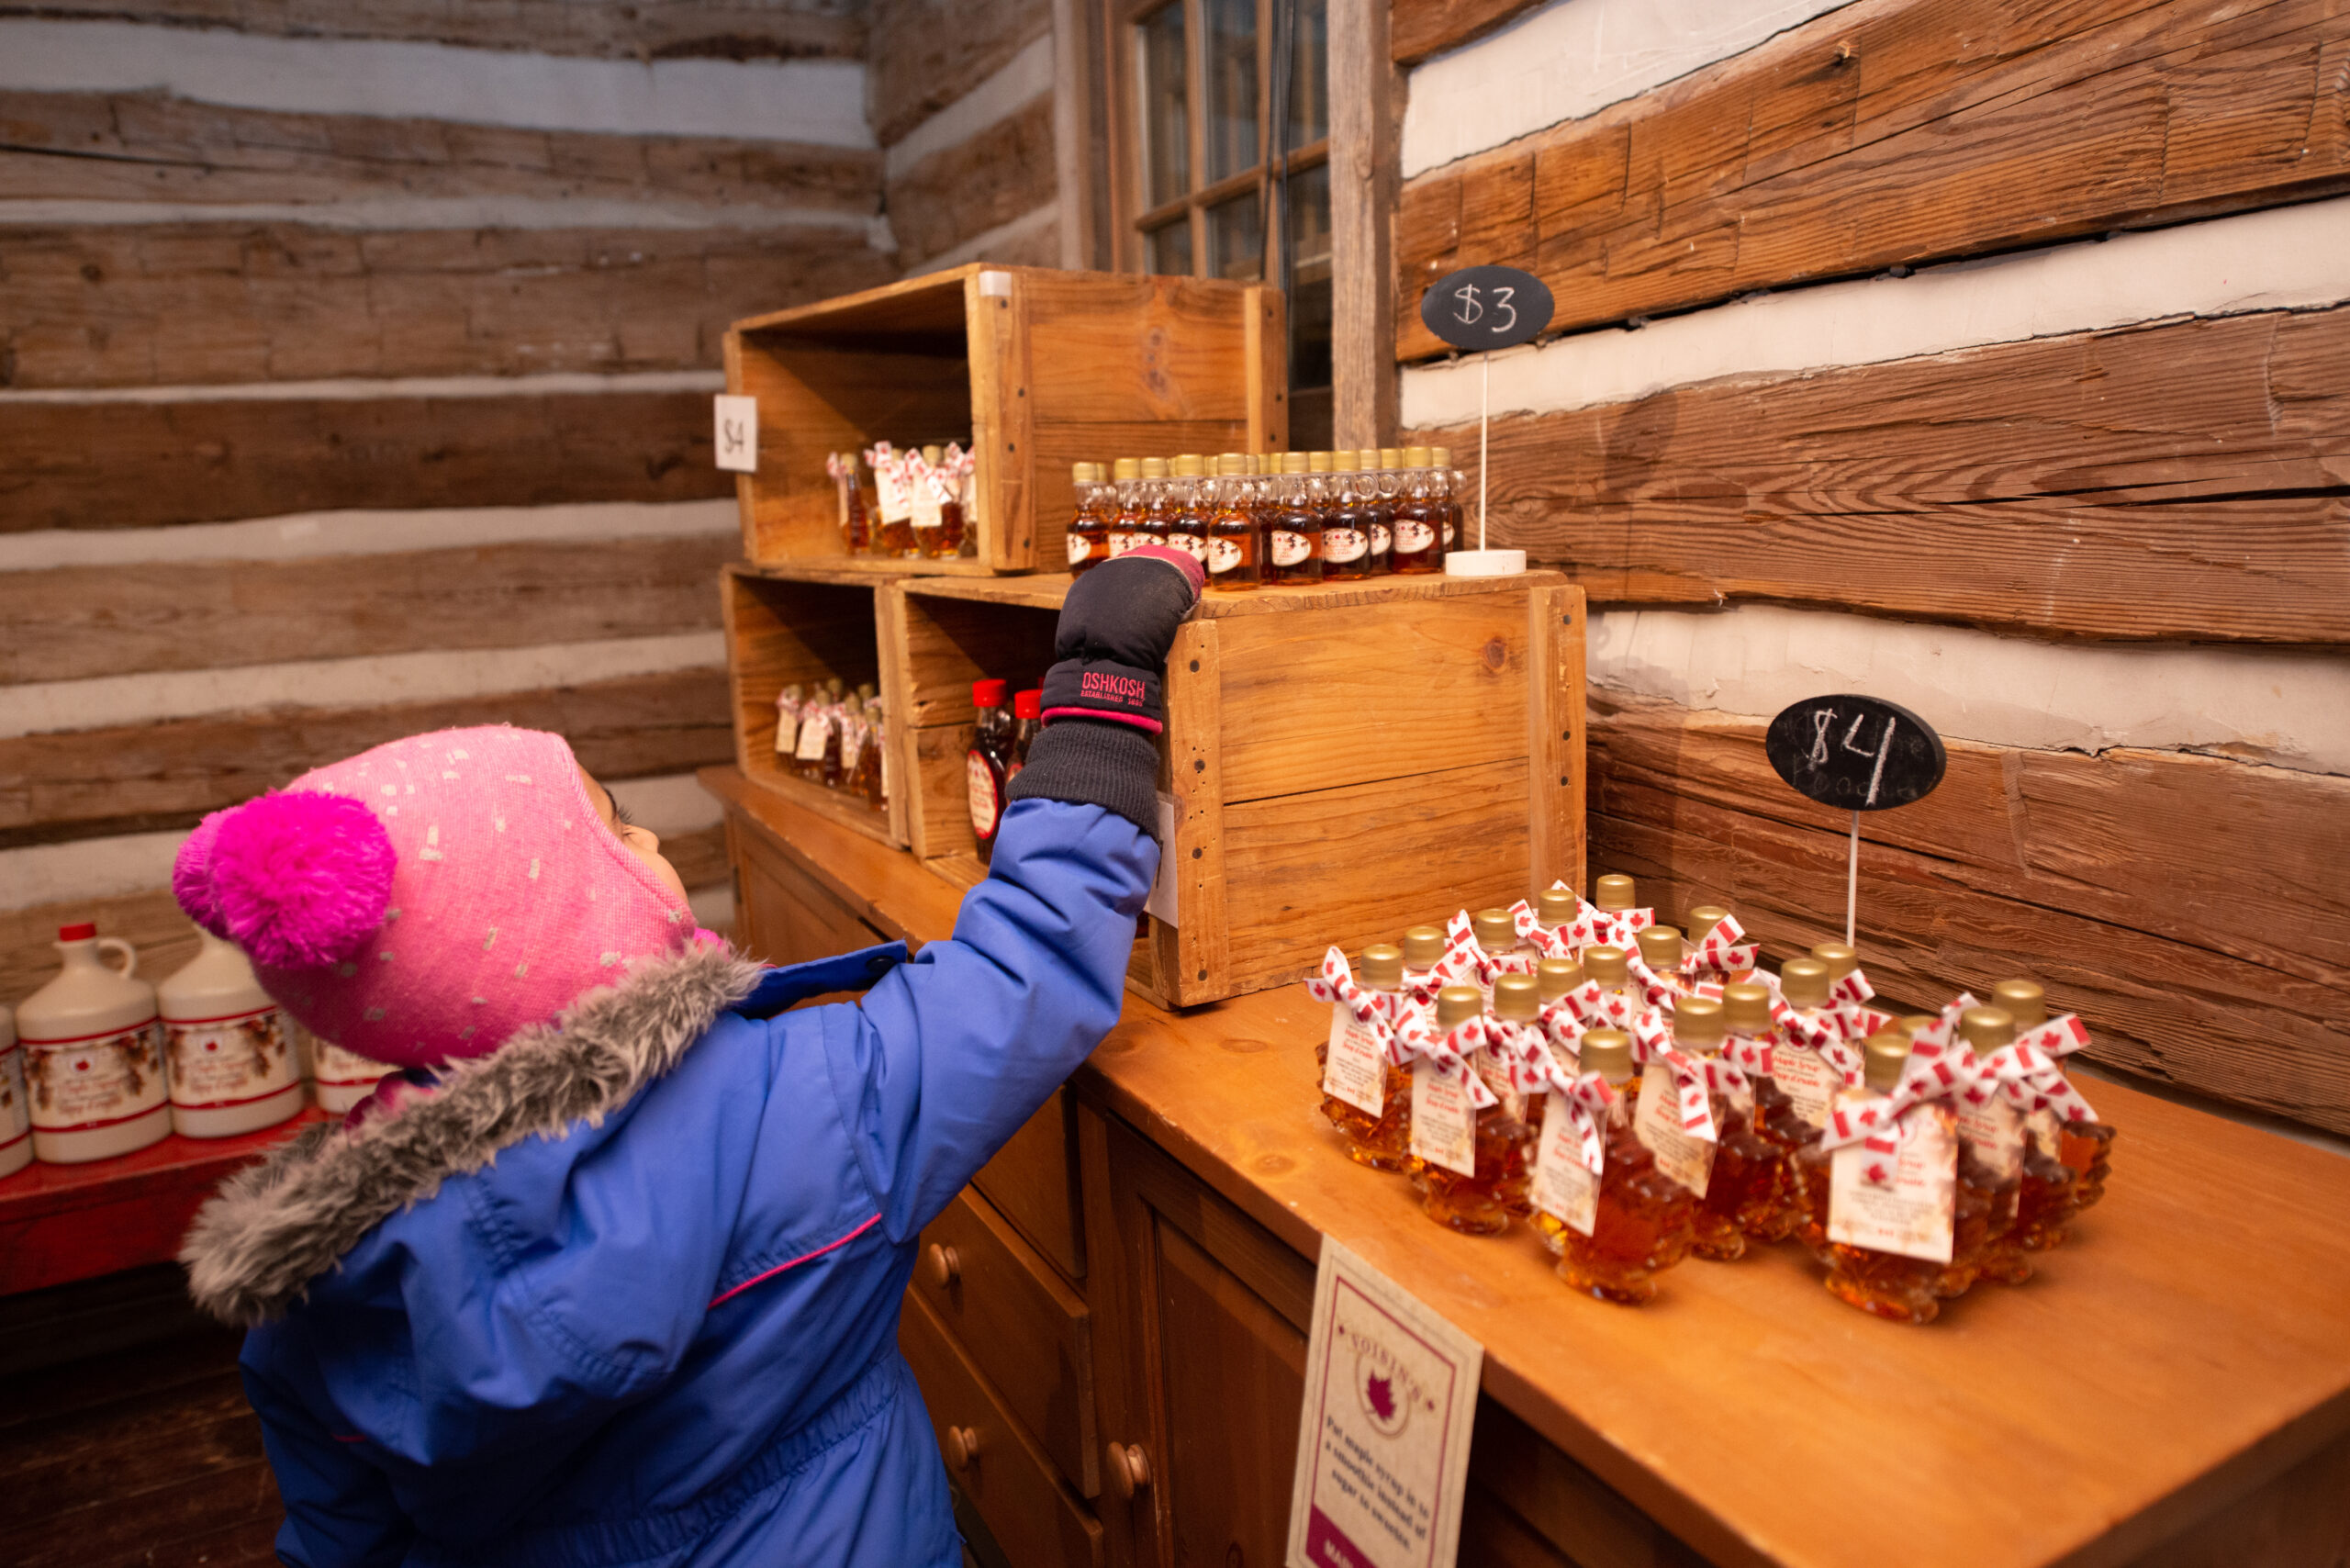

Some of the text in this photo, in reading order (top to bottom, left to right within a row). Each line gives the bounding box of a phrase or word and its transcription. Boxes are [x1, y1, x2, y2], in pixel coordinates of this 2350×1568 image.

[1453, 283, 1517, 332] $3
[1080, 689, 1124, 703] ESTABLISHED
[1081, 671, 1146, 700] OSHKOSH
[1800, 707, 1897, 807] $4
[1327, 1415, 1342, 1439] Put
[1345, 1436, 1373, 1466] maple
[1376, 1463, 1404, 1496] syrup
